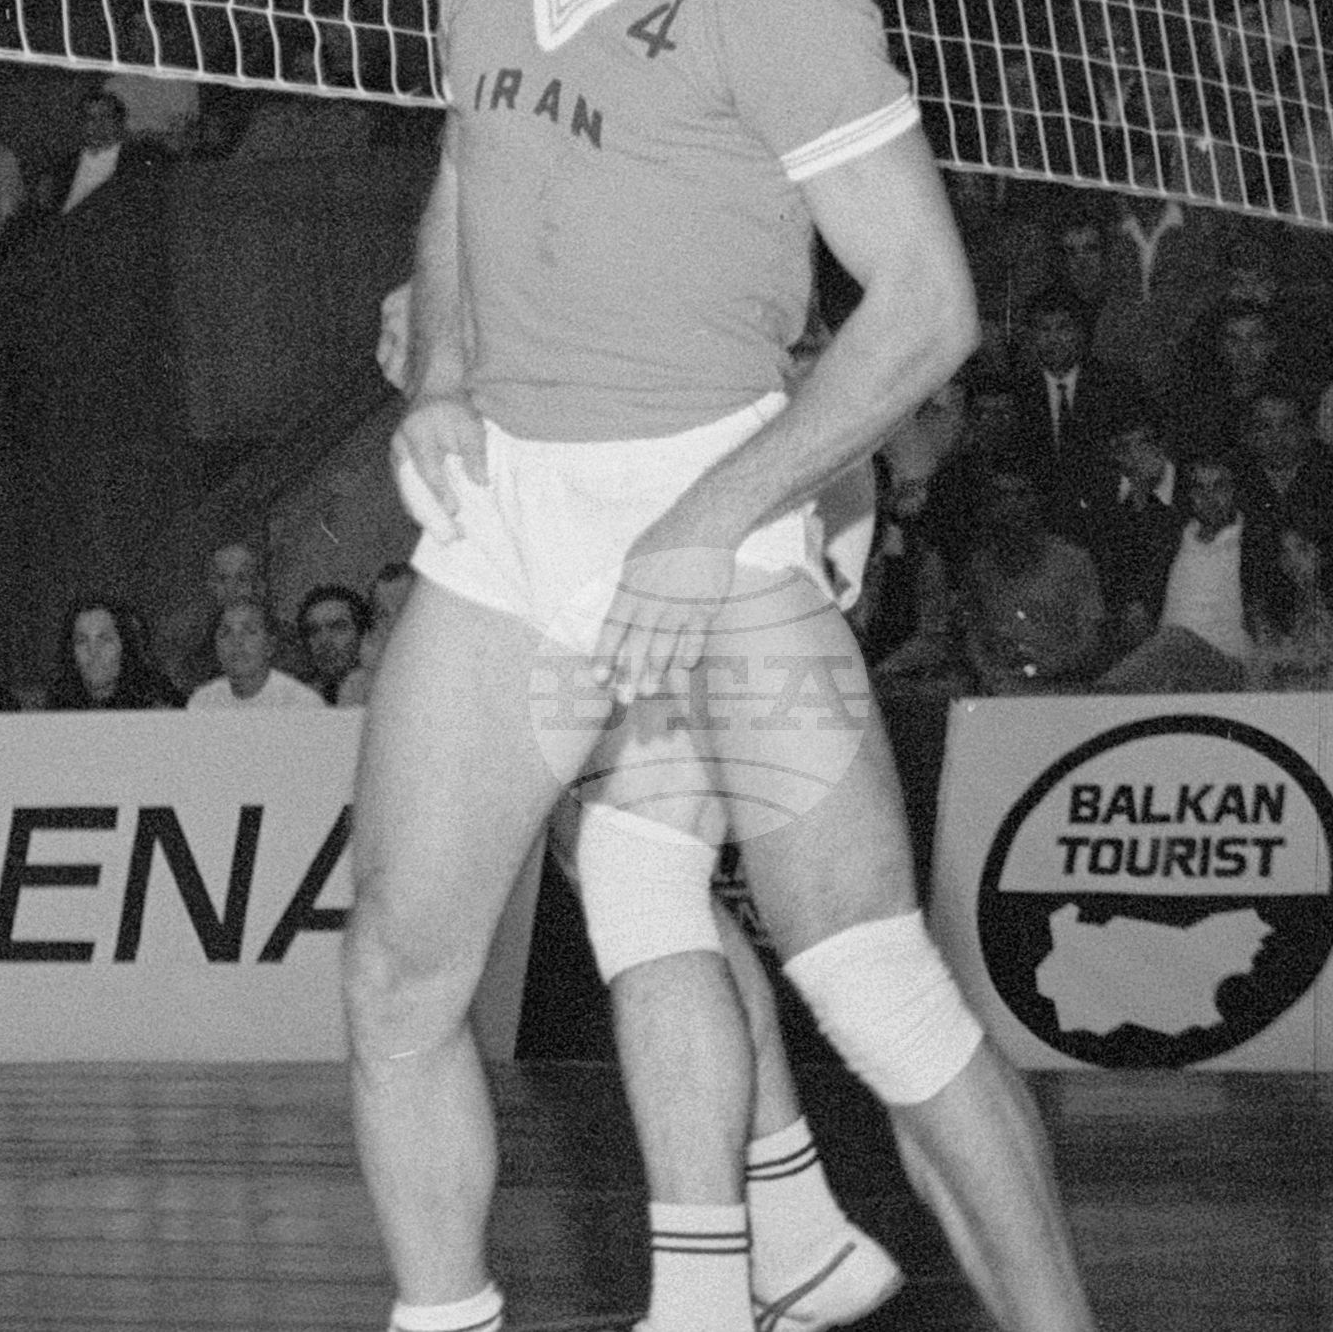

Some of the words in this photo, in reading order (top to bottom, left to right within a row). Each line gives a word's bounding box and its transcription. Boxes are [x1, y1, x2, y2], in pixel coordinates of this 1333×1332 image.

[473, 67, 604, 151] IRAN
[1069, 783, 1287, 825] BALKAN
[1057, 835, 1286, 879] TOURIST
